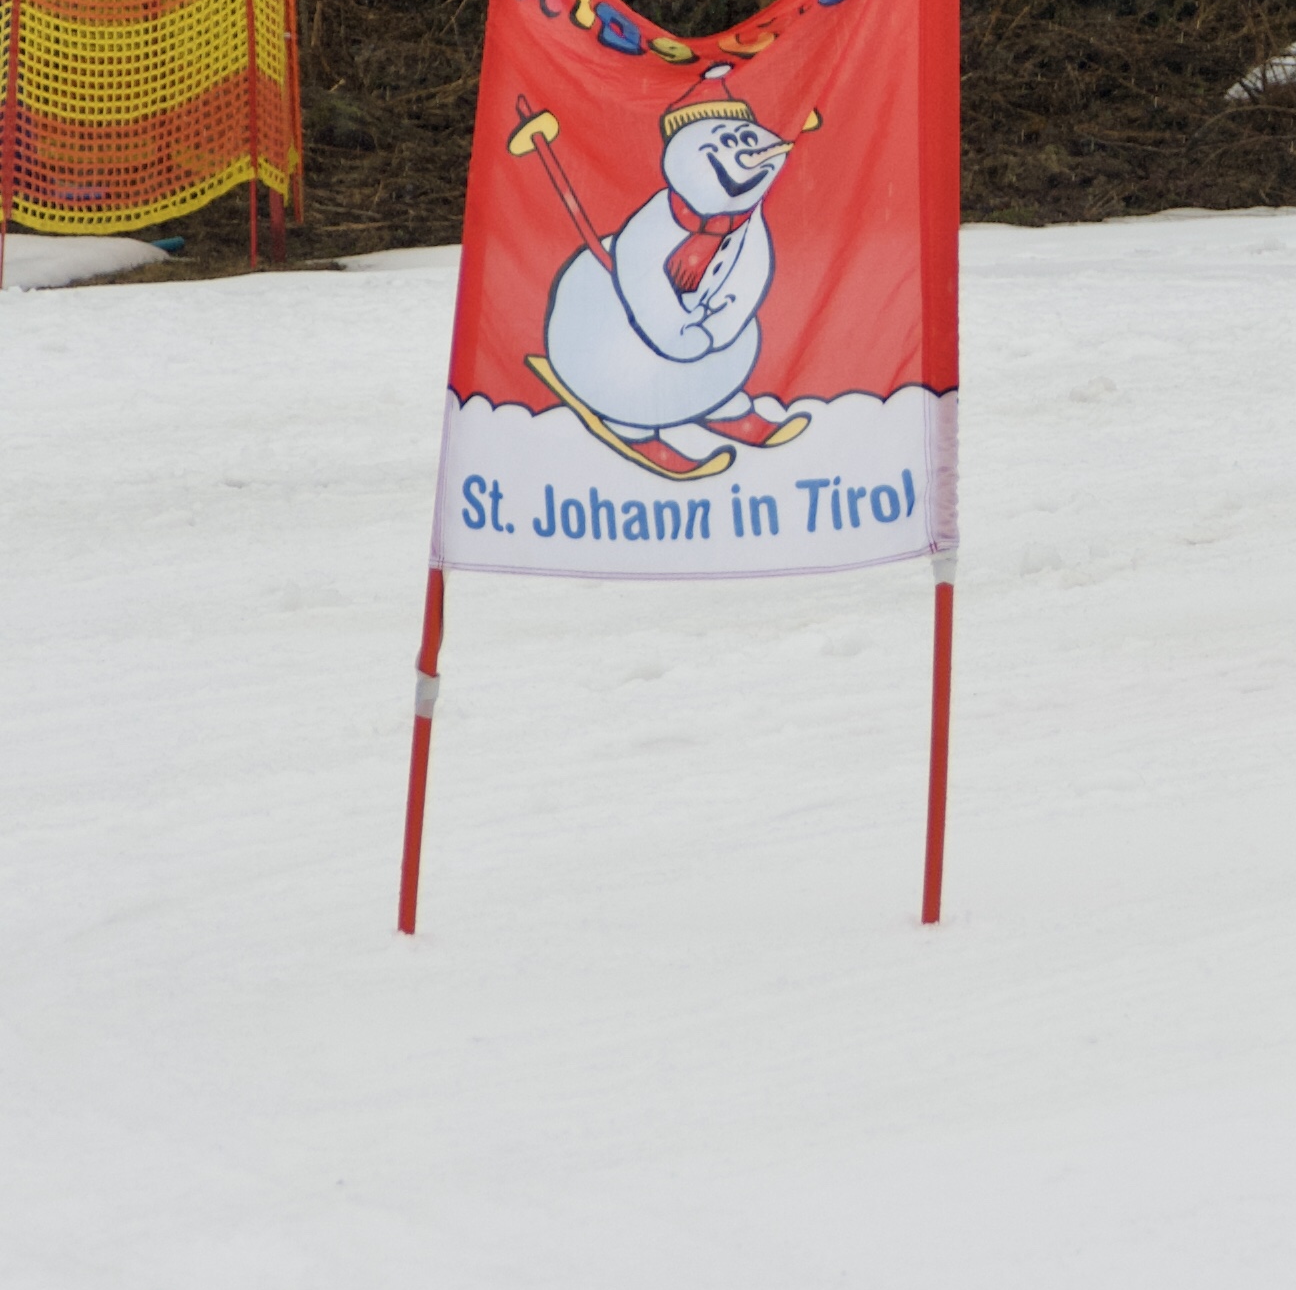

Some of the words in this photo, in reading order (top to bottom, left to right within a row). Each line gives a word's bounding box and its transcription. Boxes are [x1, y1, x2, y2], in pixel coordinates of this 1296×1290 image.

[462, 474, 515, 534] St.
[533, 483, 711, 540] Johann
[731, 483, 779, 538] in
[795, 468, 915, 533] Tirol
